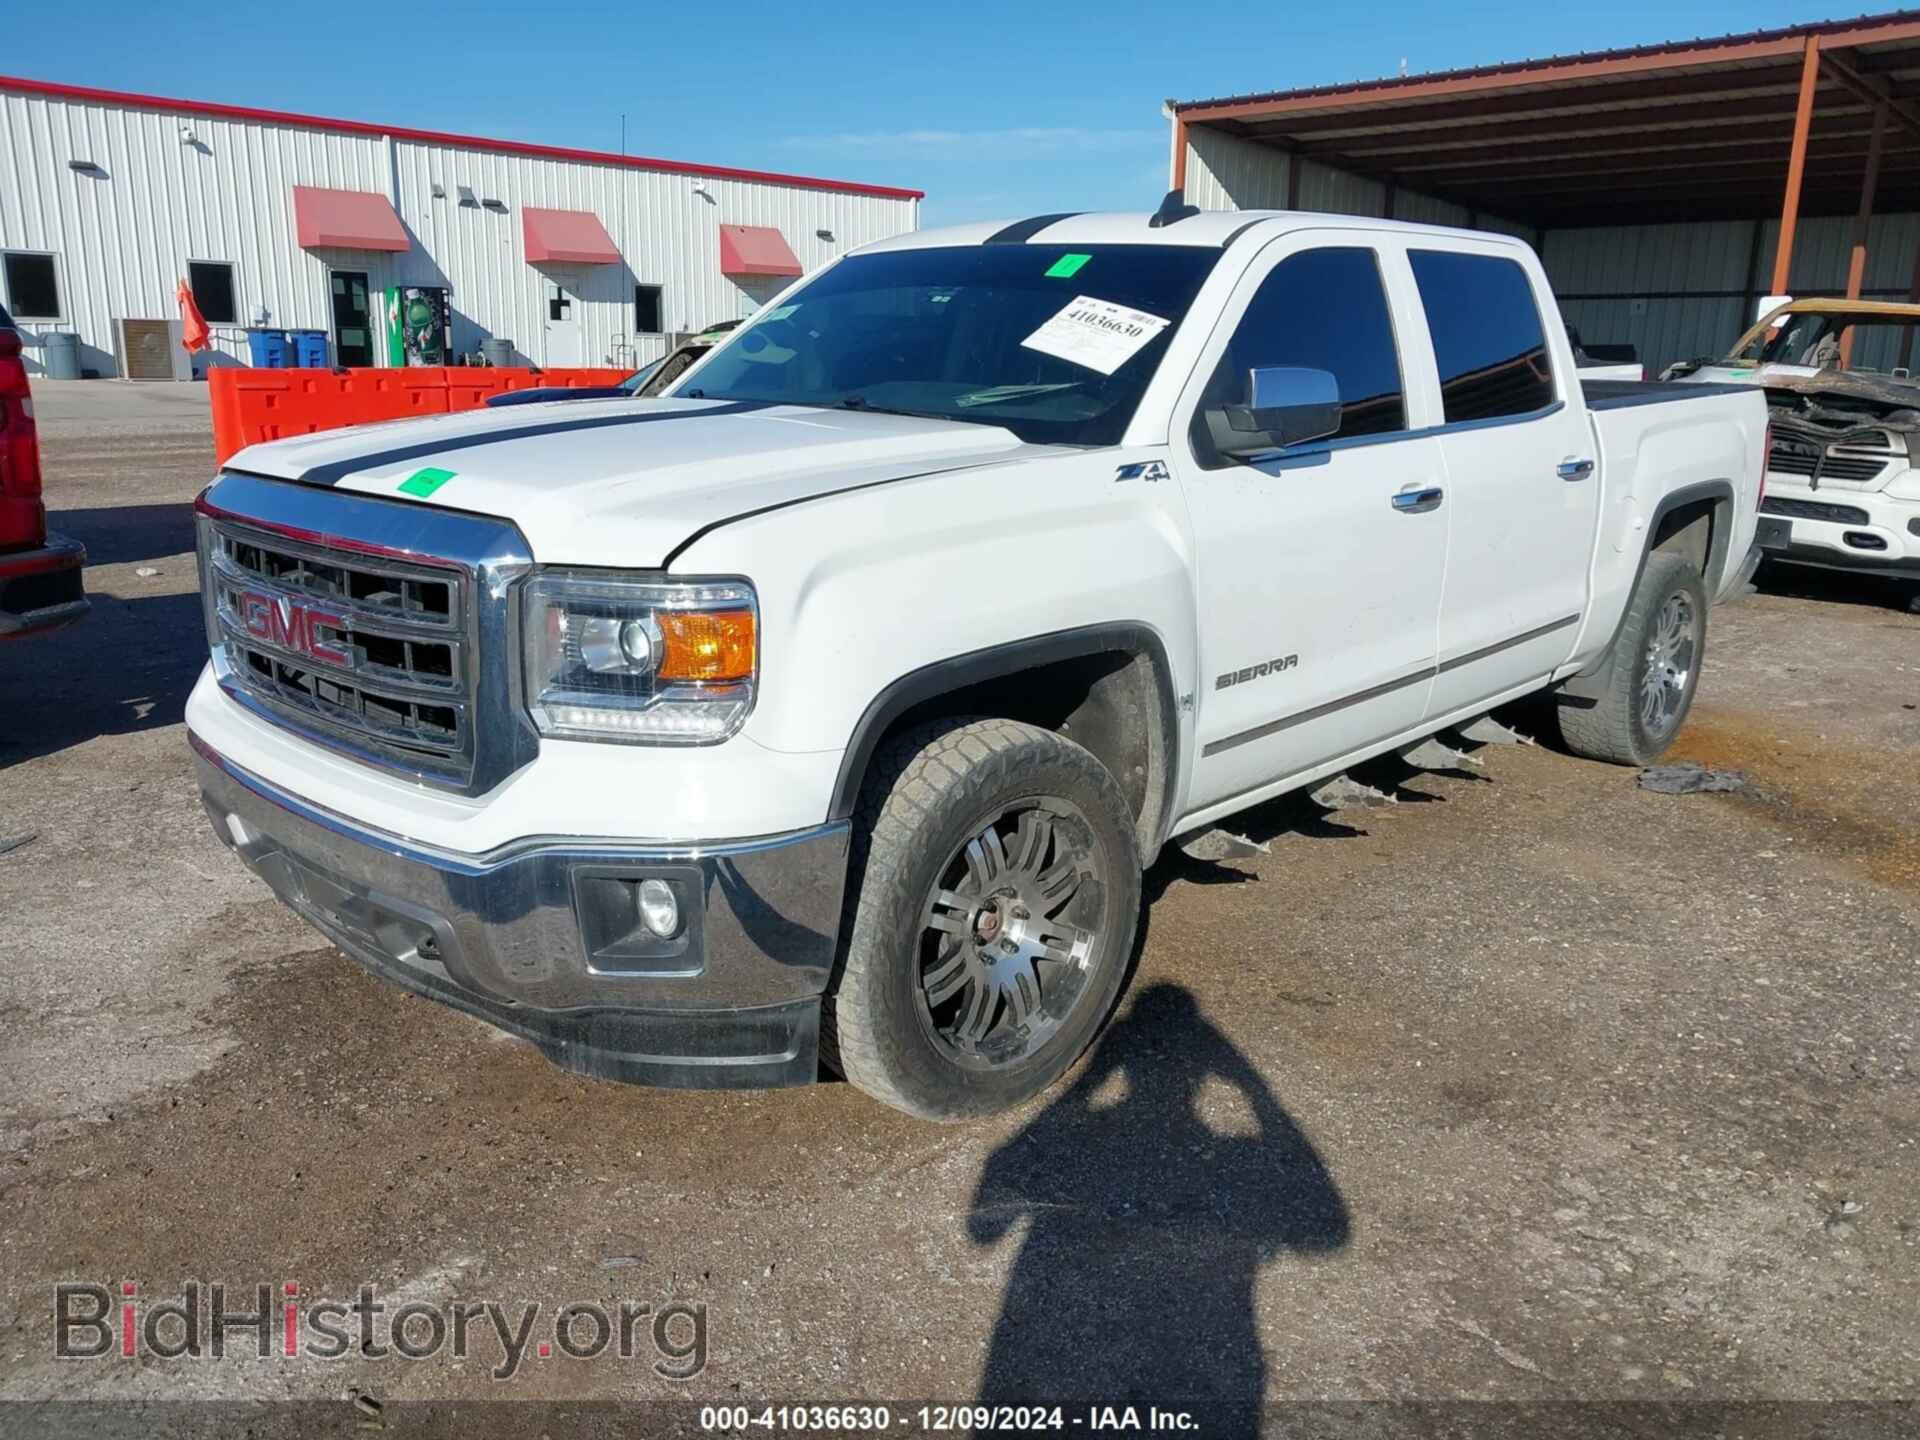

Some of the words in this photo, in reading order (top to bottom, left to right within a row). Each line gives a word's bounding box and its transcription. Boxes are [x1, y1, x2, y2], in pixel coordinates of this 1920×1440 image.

[1067, 309, 1144, 338] 41036630
[239, 590, 352, 668] GMC
[1215, 654, 1298, 690] SIERRA
